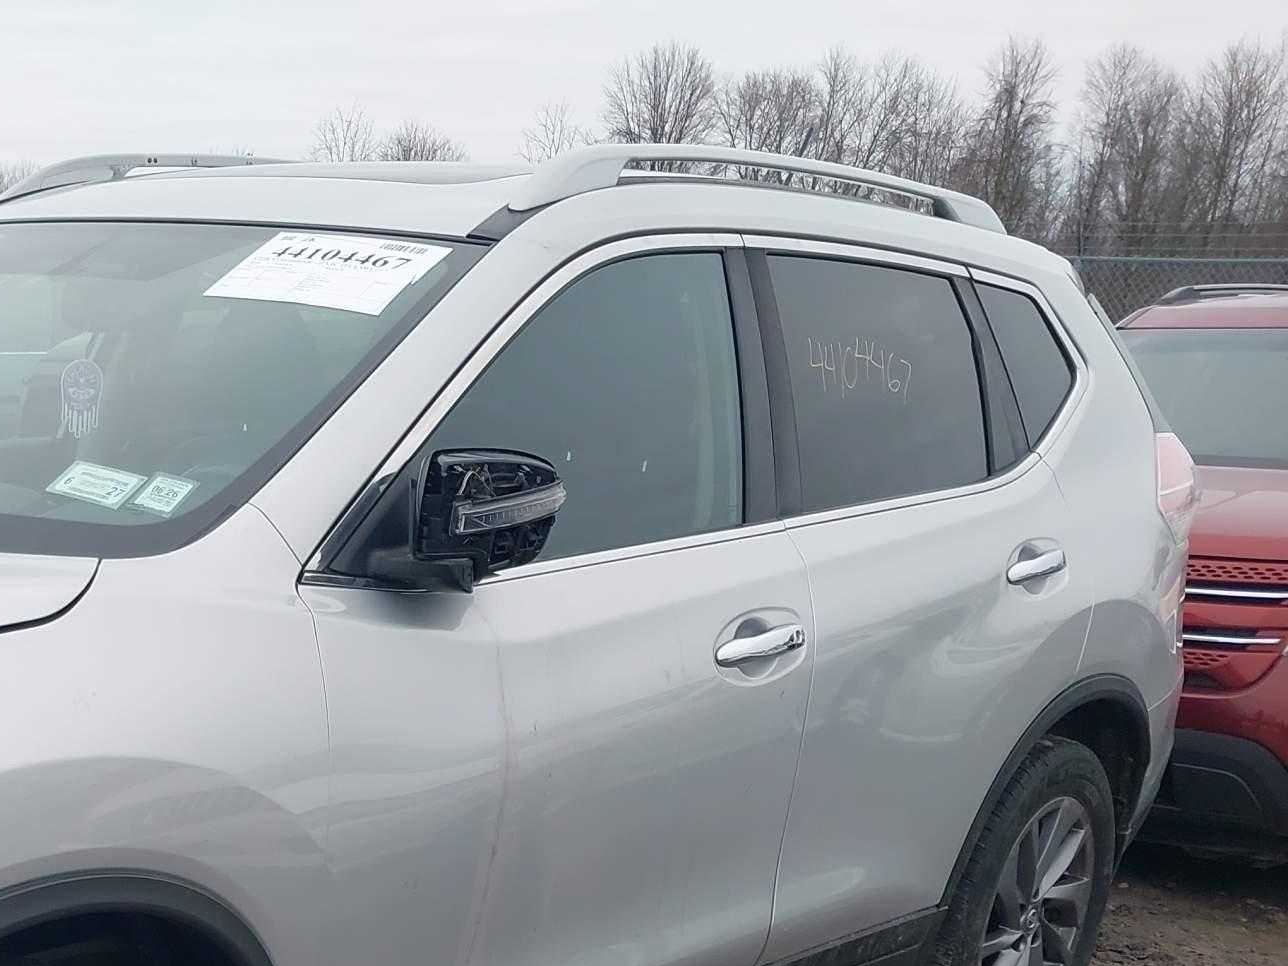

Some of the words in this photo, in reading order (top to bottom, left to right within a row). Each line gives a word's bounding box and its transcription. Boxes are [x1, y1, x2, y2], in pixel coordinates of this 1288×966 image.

[272, 246, 413, 270] 44104467
[808, 336, 912, 405] 44104467
[106, 486, 126, 498] 27
